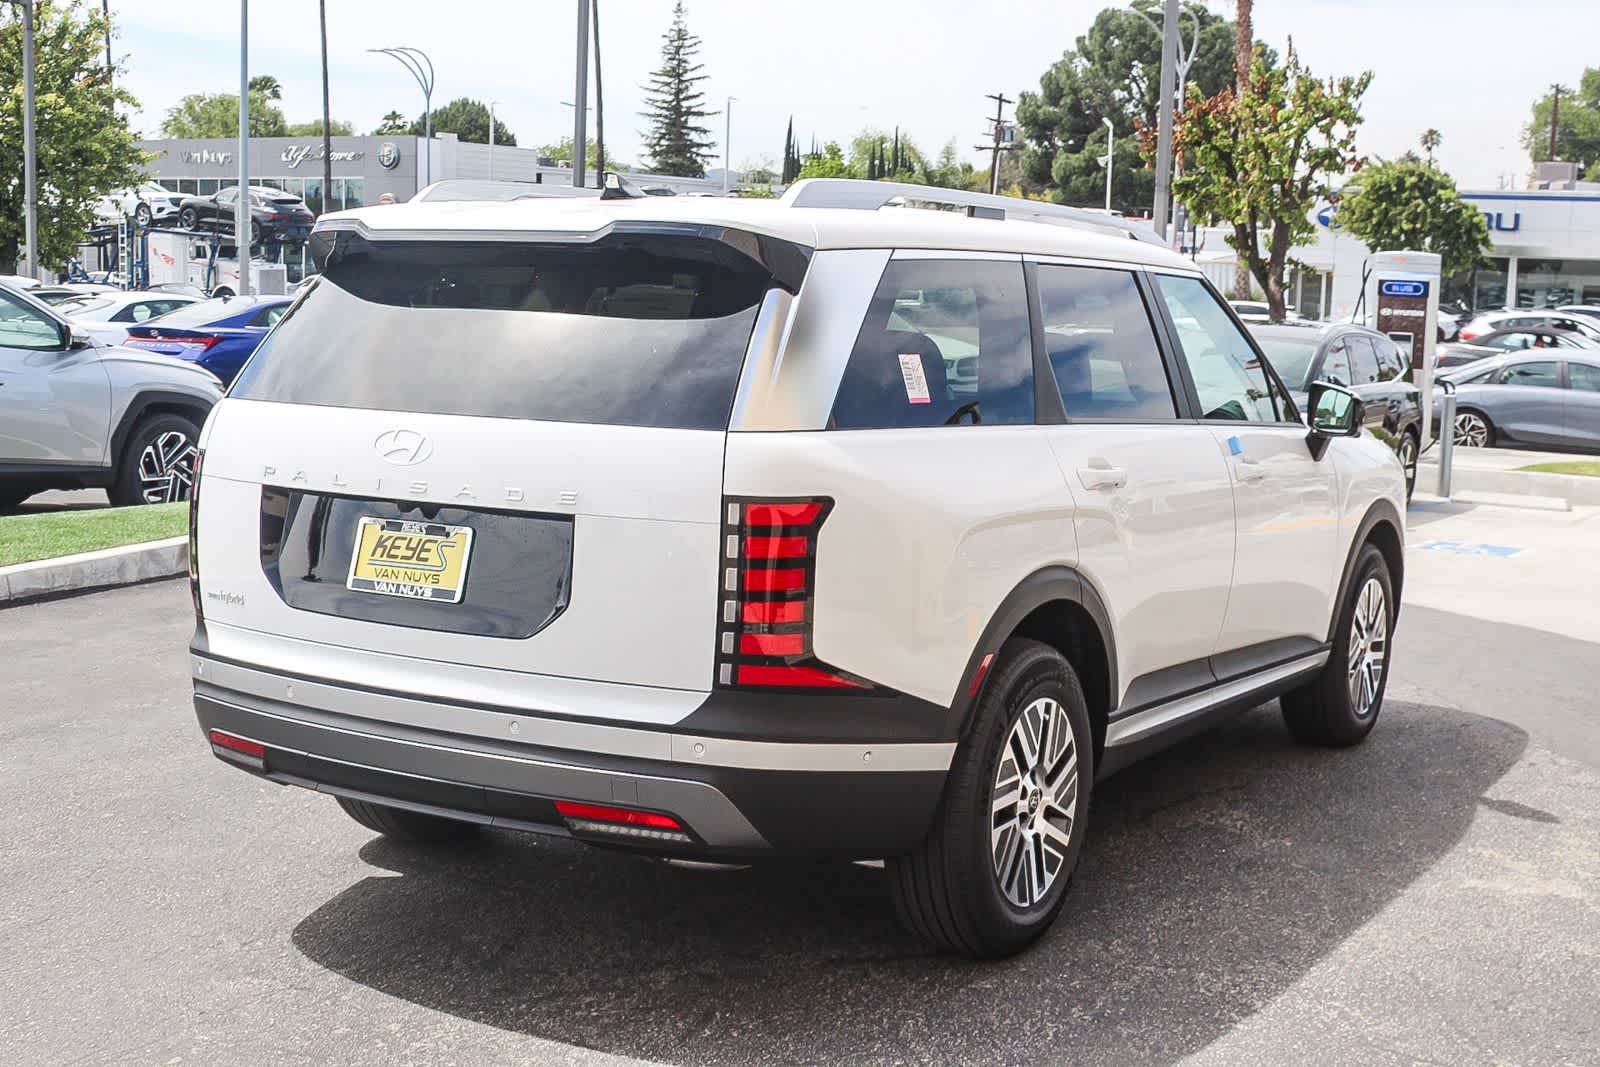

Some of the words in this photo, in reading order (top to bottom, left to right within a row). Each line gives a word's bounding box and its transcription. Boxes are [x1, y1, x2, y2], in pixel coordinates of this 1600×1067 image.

[263, 465, 578, 505] PALISADE
[370, 534, 457, 571] KEYES
[374, 567, 398, 580] VAN
[403, 570, 441, 584] NUYS
[374, 581, 396, 592] VAN
[398, 585, 433, 598] NUYS
